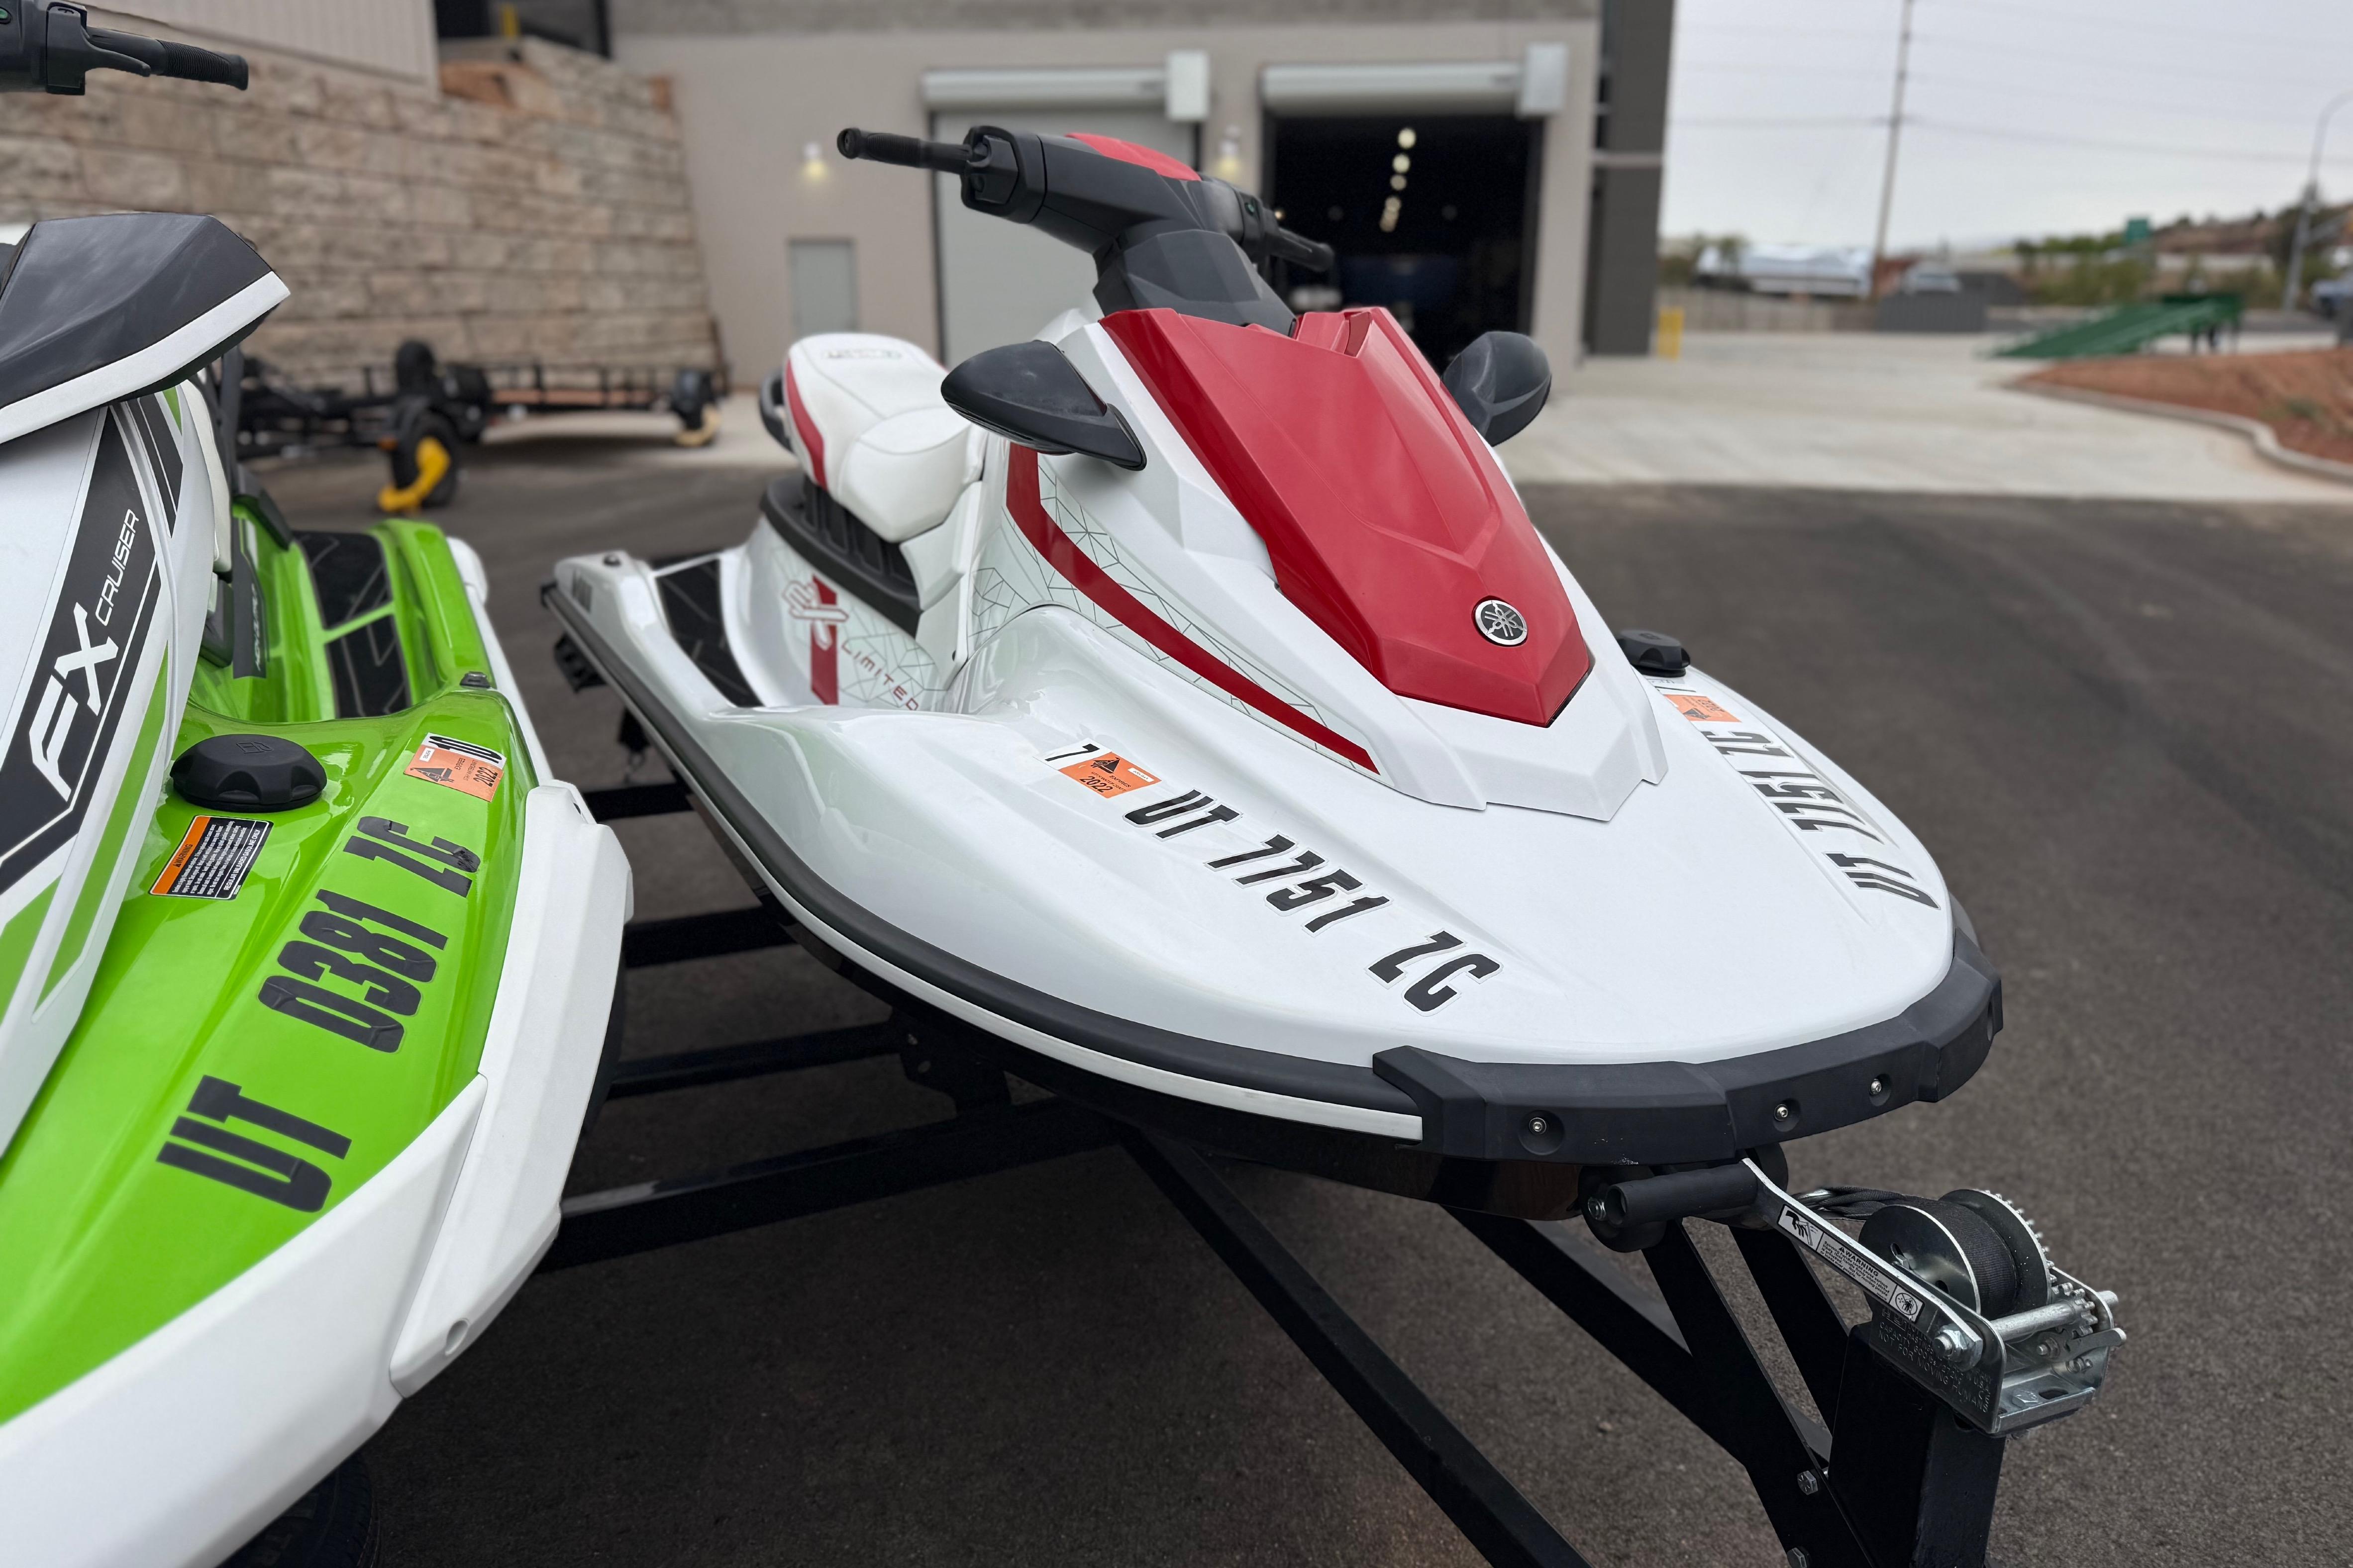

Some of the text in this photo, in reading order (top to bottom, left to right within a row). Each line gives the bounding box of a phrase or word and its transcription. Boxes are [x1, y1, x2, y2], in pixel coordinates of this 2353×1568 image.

[95, 508, 139, 626] CRUISER
[29, 602, 118, 802] FX
[841, 639, 919, 711] LIMITED
[428, 736, 503, 764] 10
[473, 767, 498, 787] 2022
[1045, 743, 1100, 762] 7
[1079, 776, 1113, 793] 2022
[1738, 770, 1881, 843] 7751
[176, 844, 193, 866] WARNING
[223, 874, 238, 890] REGULAR
[252, 829, 261, 839] ONLY
[1825, 853, 1940, 909] UT
[1125, 789, 1501, 1012] UT 7751 ZC
[156, 815, 481, 1212] UT 0381 ZC
[1844, 1250, 1879, 1277] WARNING
[1878, 1329, 1895, 1346] NOT
[1898, 1343, 1914, 1362] FOR
[1916, 1356, 1949, 1385] MOVING
[1879, 1321, 1911, 1348] CAPACITY
